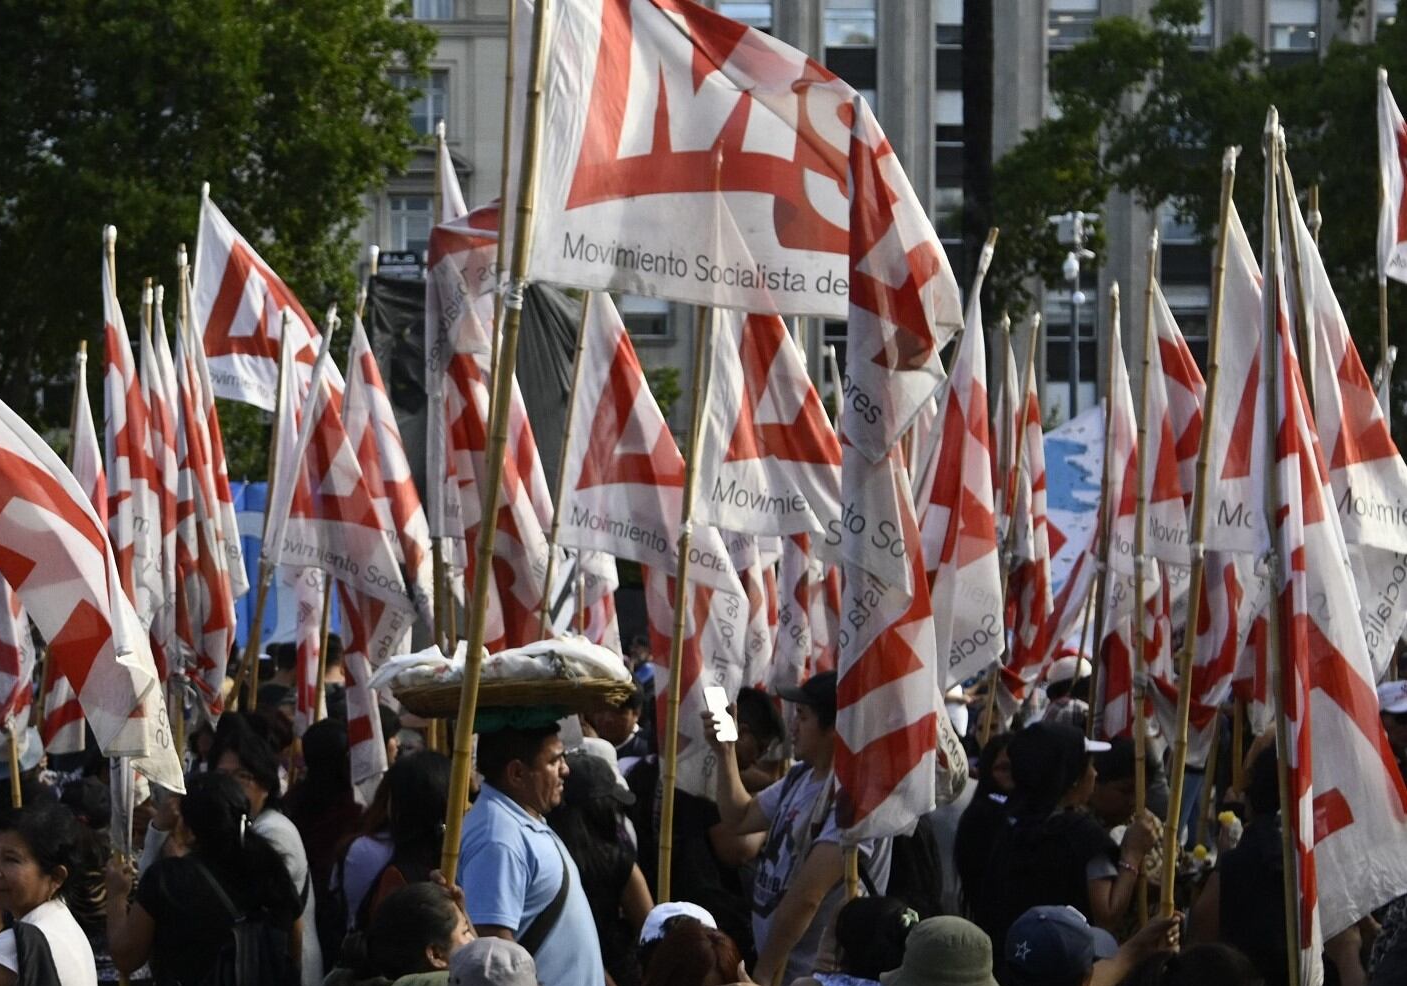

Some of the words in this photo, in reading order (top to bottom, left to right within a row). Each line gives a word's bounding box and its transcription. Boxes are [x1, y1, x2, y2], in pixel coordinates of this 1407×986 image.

[562, 231, 688, 278] Movimiento
[695, 254, 807, 293] Socialista
[815, 269, 850, 297] de
[712, 476, 813, 514] Movimie
